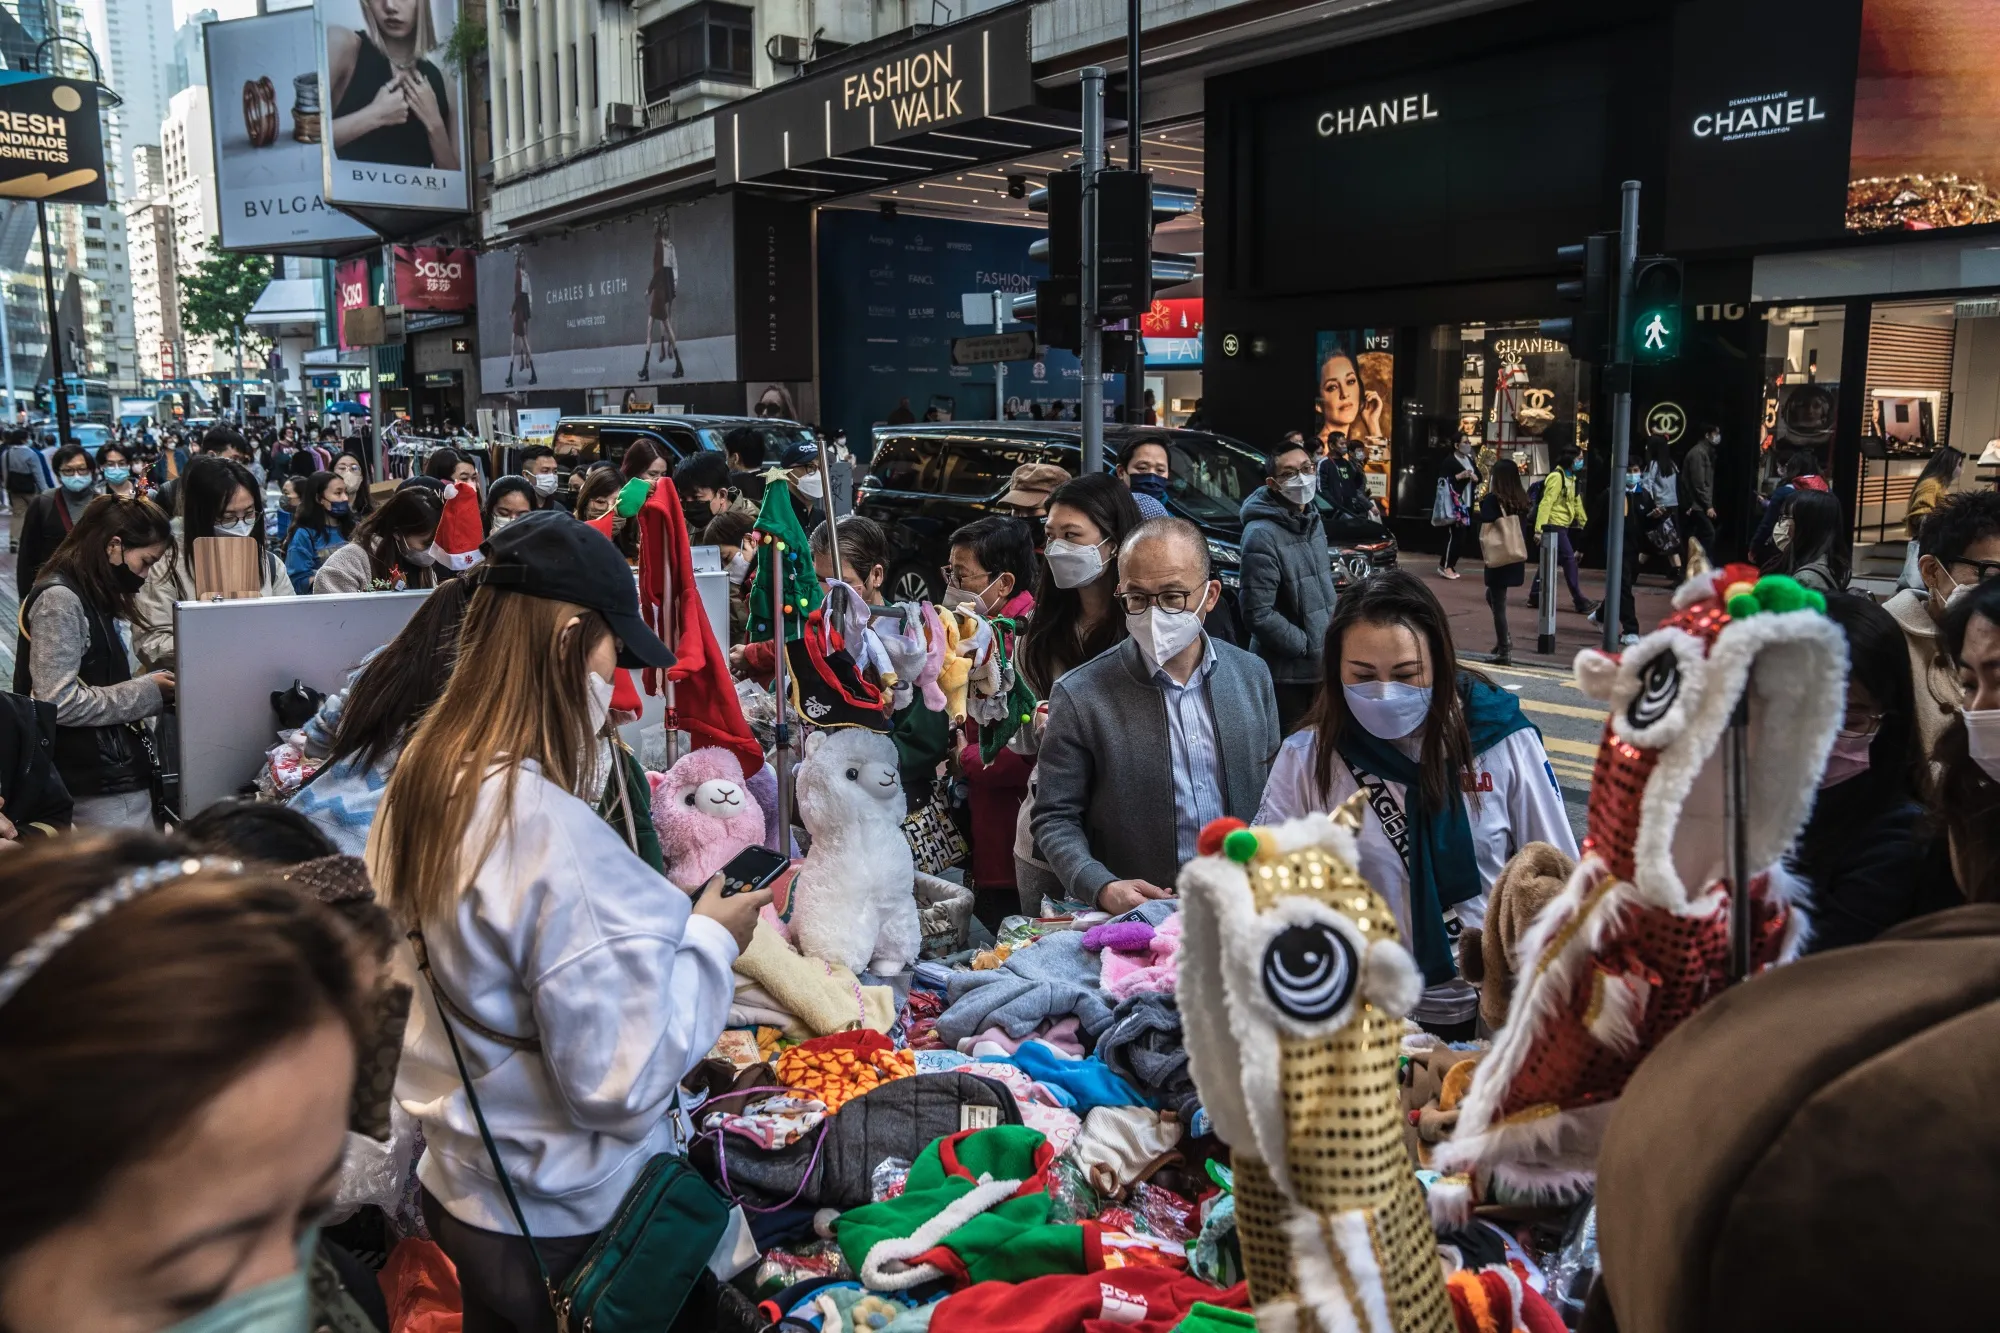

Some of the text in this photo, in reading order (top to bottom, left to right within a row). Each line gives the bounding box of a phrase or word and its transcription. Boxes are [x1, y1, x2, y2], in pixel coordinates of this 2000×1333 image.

[844, 44, 952, 111] FASHION
[891, 79, 963, 130] WALK
[1763, 93, 1771, 101] LA
[1771, 90, 1789, 99] LUNE
[0, 110, 67, 137] RESH
[1316, 92, 1439, 137] CHANEL
[1692, 96, 1826, 138] CHANEL
[352, 169, 448, 189] BVLGARI
[244, 194, 326, 218] BVLGA
[767, 225, 777, 287] CHARLES
[426, 278, 451, 292] 莎莎
[546, 278, 628, 305] CHARLES & KEITH
[908, 274, 935, 285] FANCL
[975, 271, 1032, 287] FASHION
[768, 312, 777, 352] KEITH
[1495, 338, 1564, 353] CHANEL
